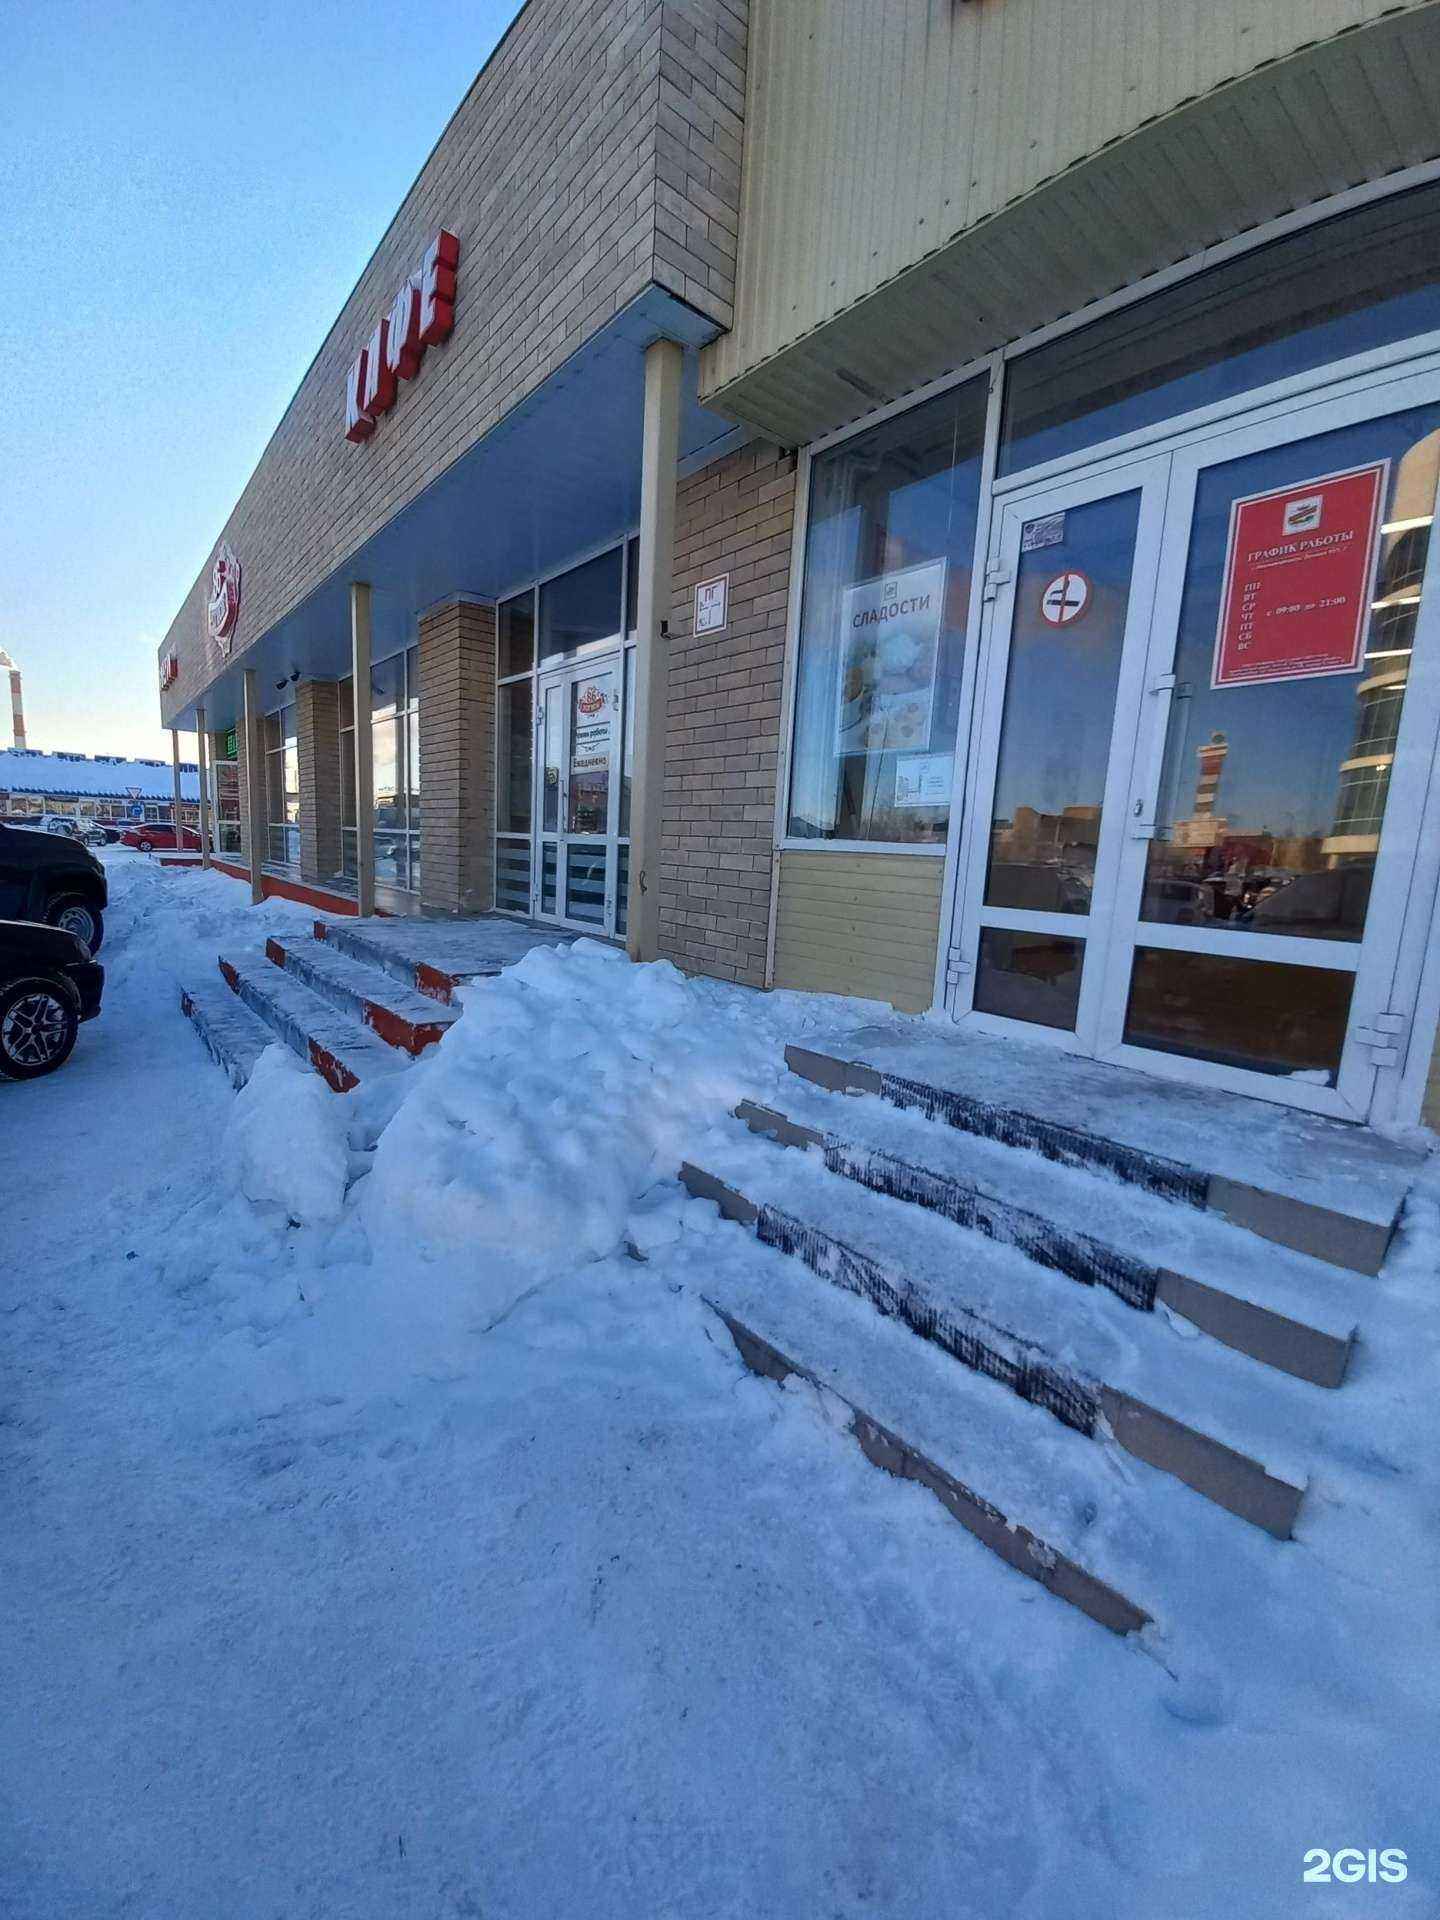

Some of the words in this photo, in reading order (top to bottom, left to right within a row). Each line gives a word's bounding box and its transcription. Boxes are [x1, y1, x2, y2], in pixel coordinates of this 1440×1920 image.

[1247, 542, 1297, 562] ГРАФИК
[1299, 529, 1354, 551] РАБОТЫ
[853, 594, 930, 628] СЛАДОСТИ
